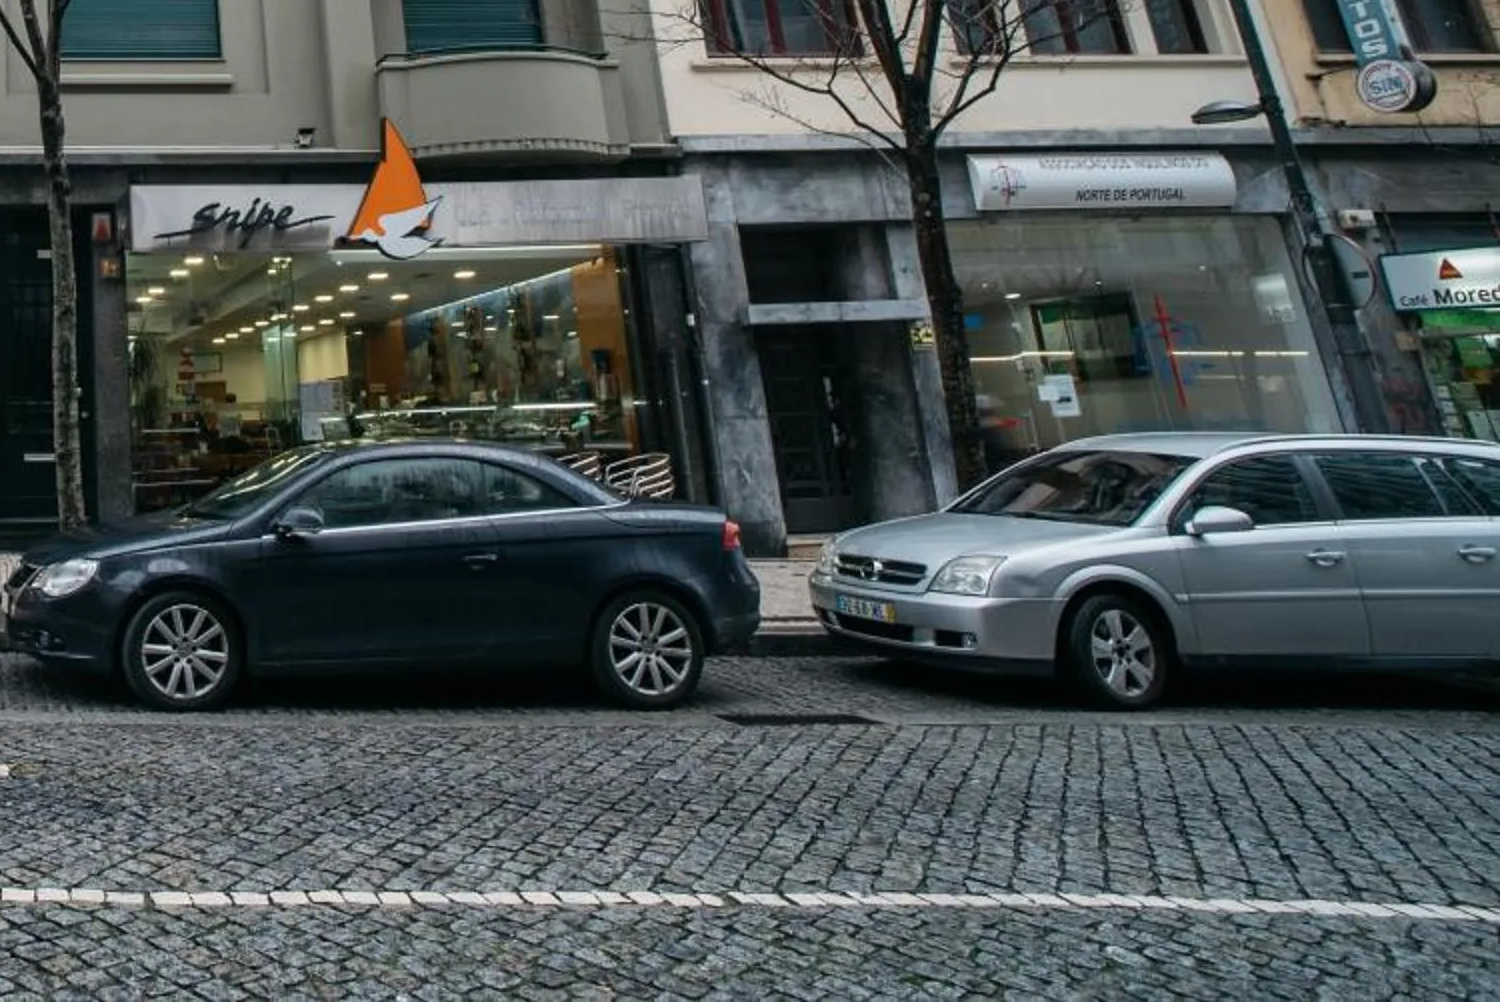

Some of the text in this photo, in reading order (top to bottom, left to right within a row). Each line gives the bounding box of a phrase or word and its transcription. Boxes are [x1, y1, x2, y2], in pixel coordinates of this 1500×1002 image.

[1075, 186, 1185, 203] NORTE DE PORTUGAL
